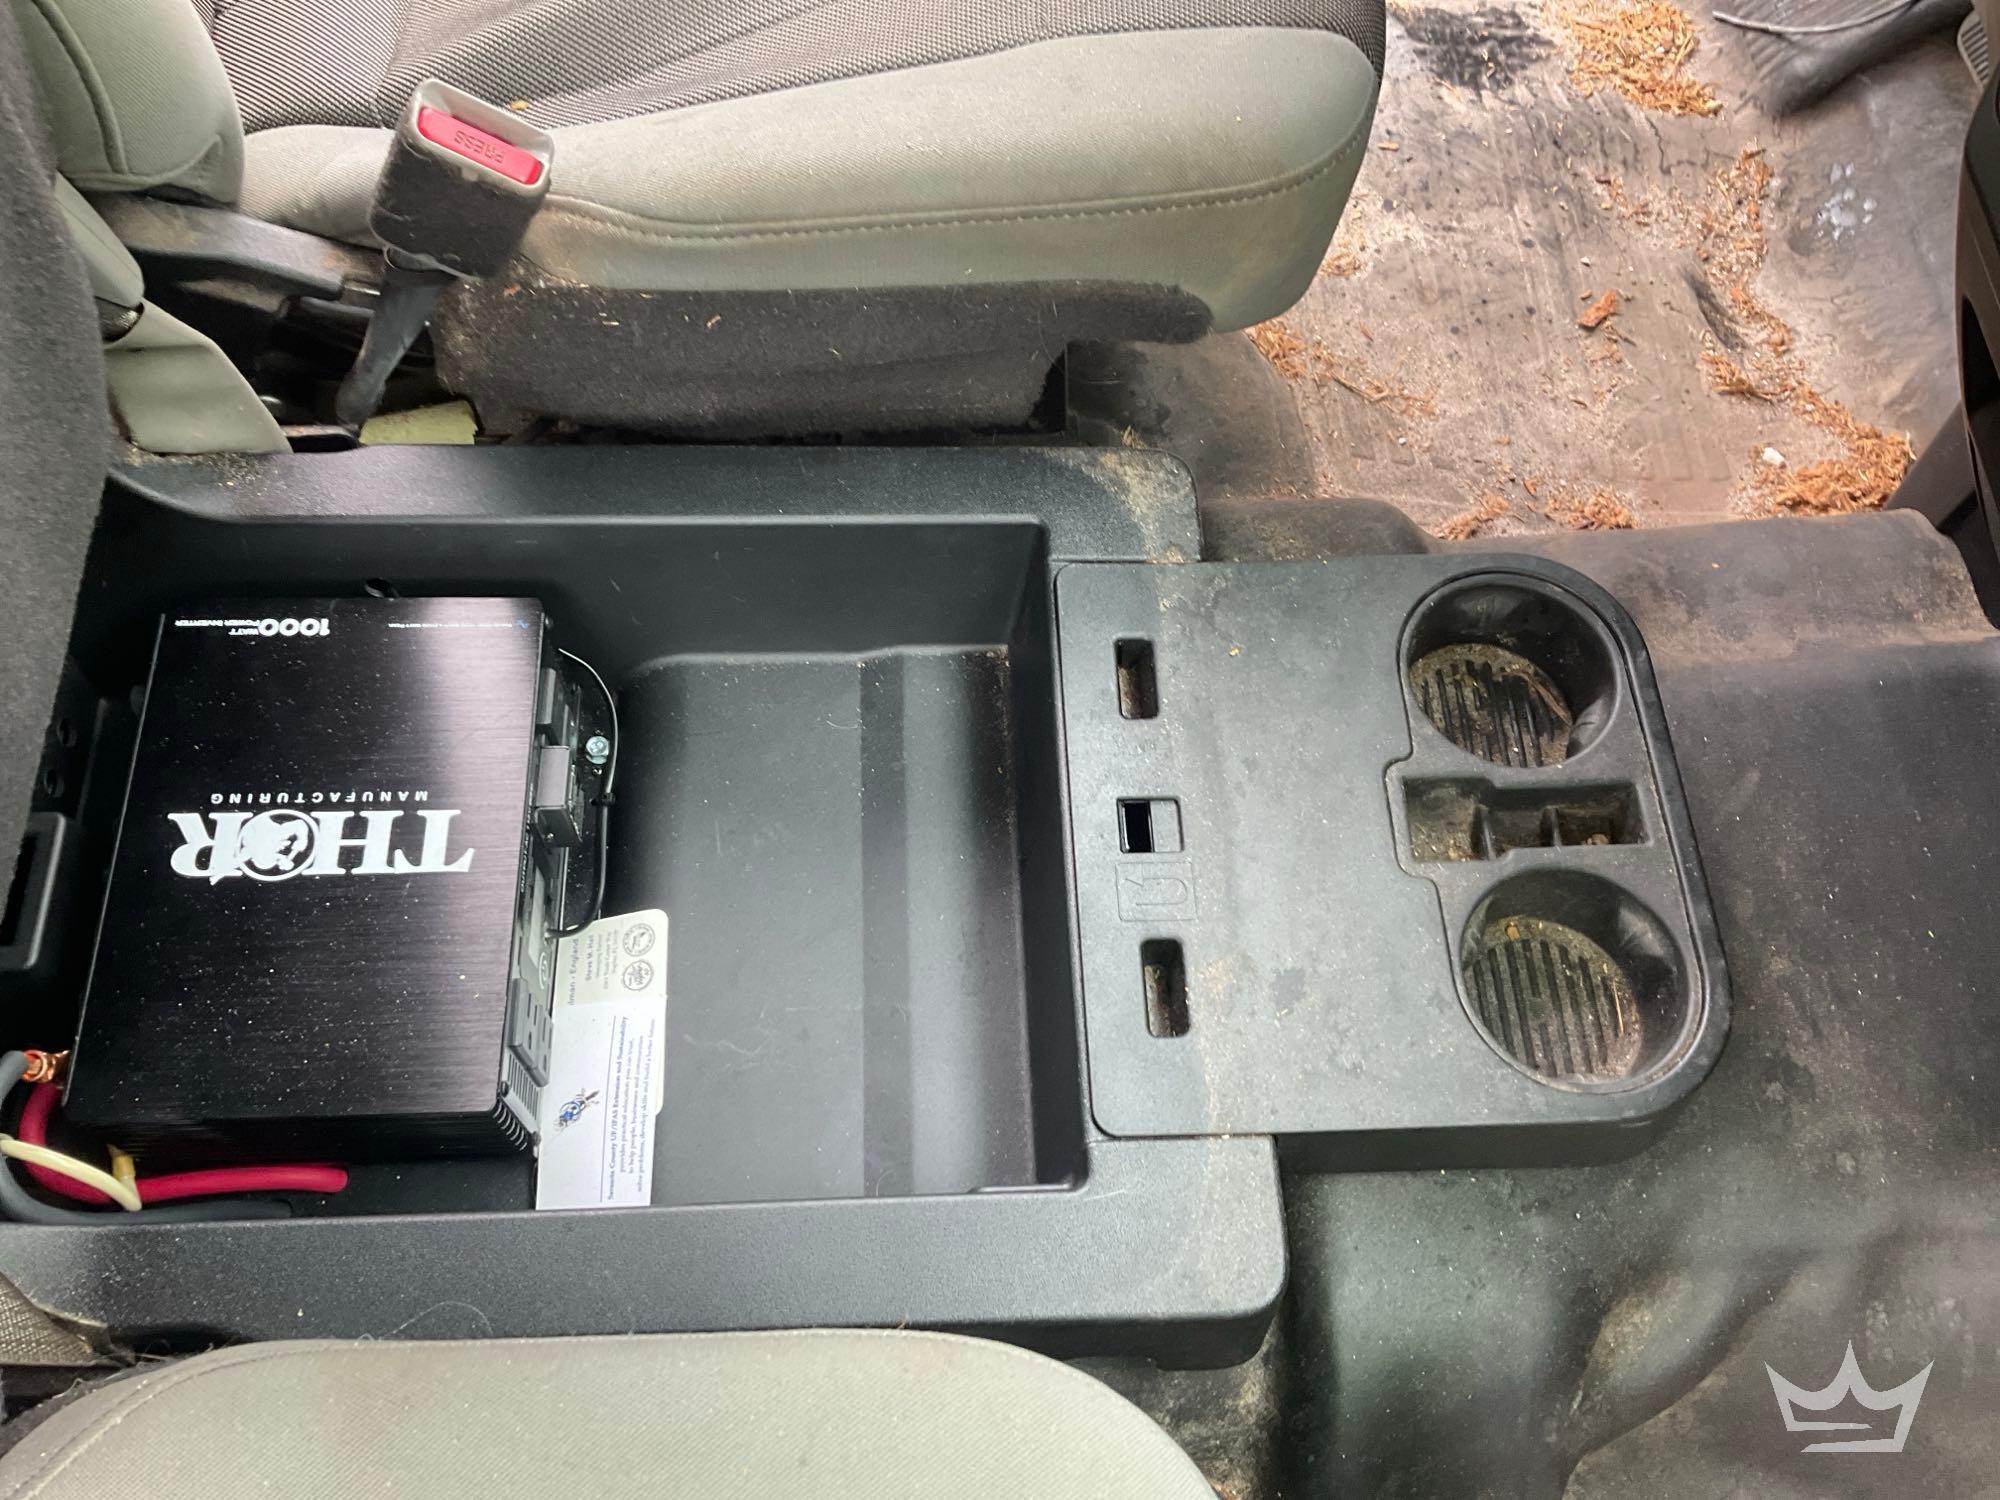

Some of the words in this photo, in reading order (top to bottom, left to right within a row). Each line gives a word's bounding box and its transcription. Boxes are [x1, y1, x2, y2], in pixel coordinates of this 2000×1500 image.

[454, 130, 504, 164] PRESS
[174, 619, 223, 627] INVERTER
[223, 619, 259, 627] POWER
[228, 627, 259, 636] WATT
[258, 617, 331, 637] 1000
[210, 791, 429, 804] MANUFACTURING
[167, 808, 475, 886] THOR
[569, 938, 579, 974] England
[584, 961, 593, 982] Steve
[617, 1016, 629, 1060] Sustainability
[610, 1109, 618, 1141] UF/IFAS
[639, 1113, 648, 1139] develop
[609, 1143, 618, 1169] County
